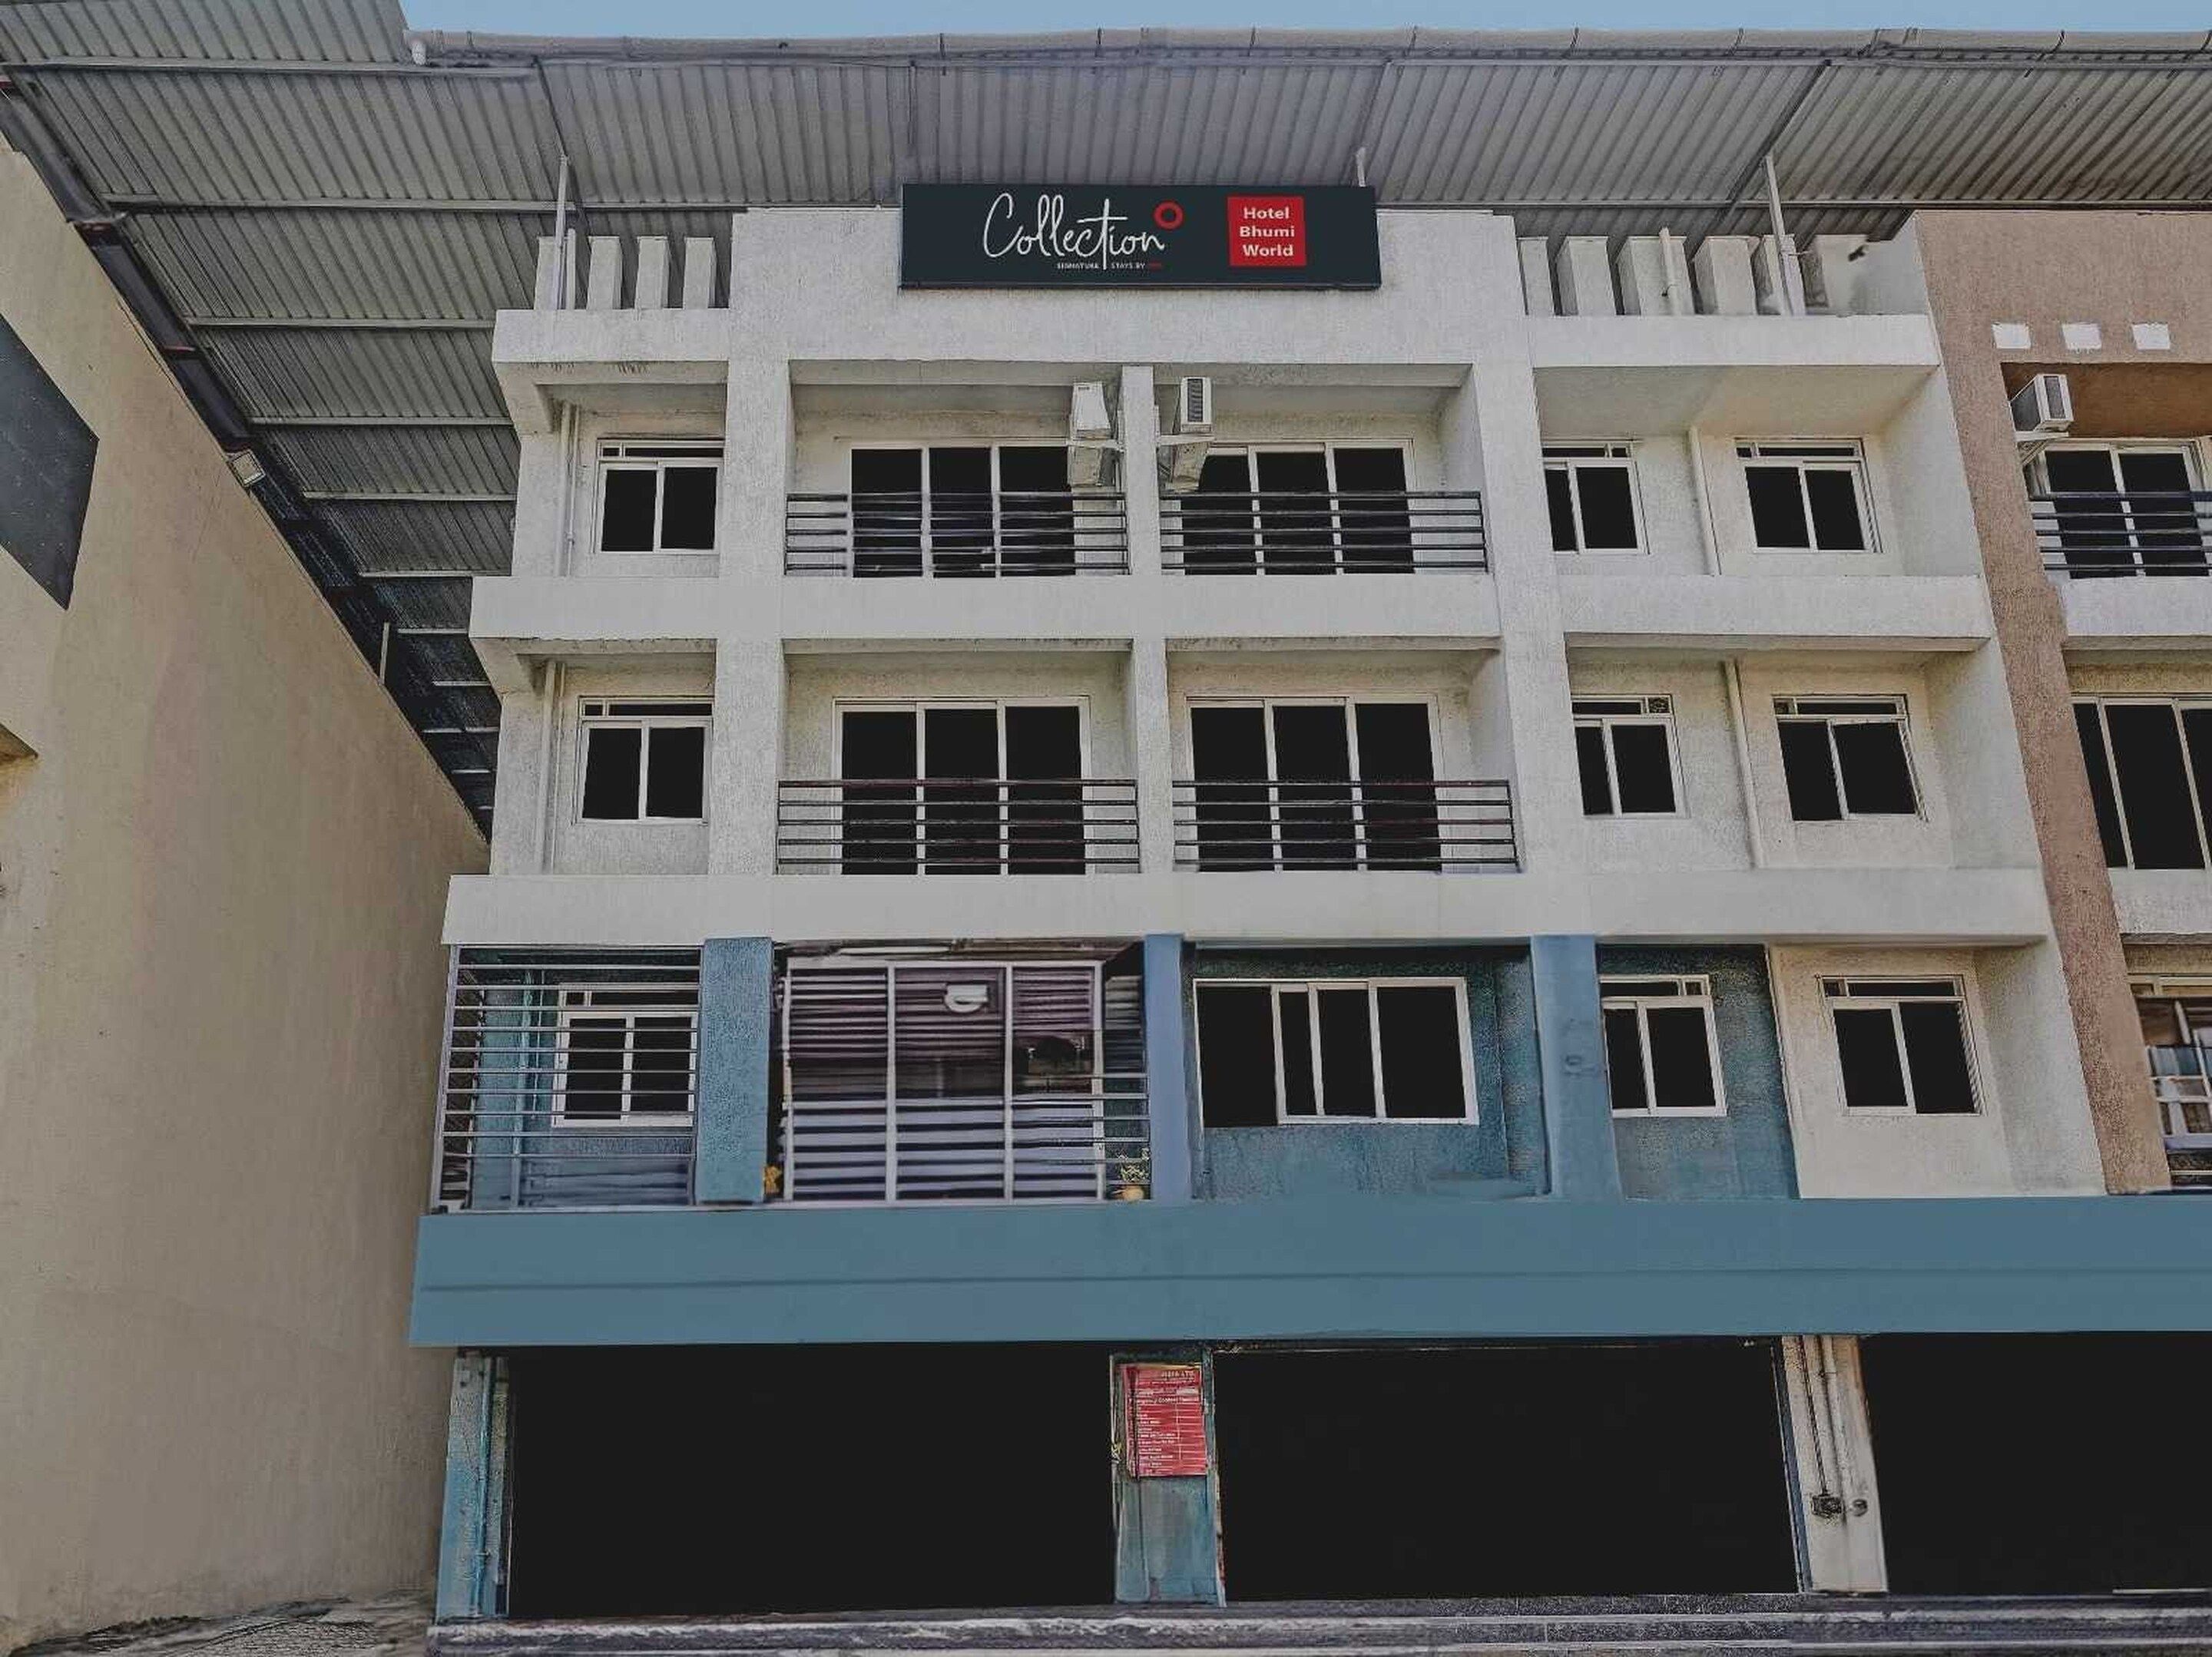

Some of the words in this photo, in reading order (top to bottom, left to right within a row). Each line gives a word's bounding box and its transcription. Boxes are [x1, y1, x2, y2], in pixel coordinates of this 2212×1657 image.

[1243, 207, 1290, 220] Hotel
[983, 193, 1165, 270] Collection
[1240, 226, 1295, 237] Bhumi
[1243, 244, 1293, 256] World
